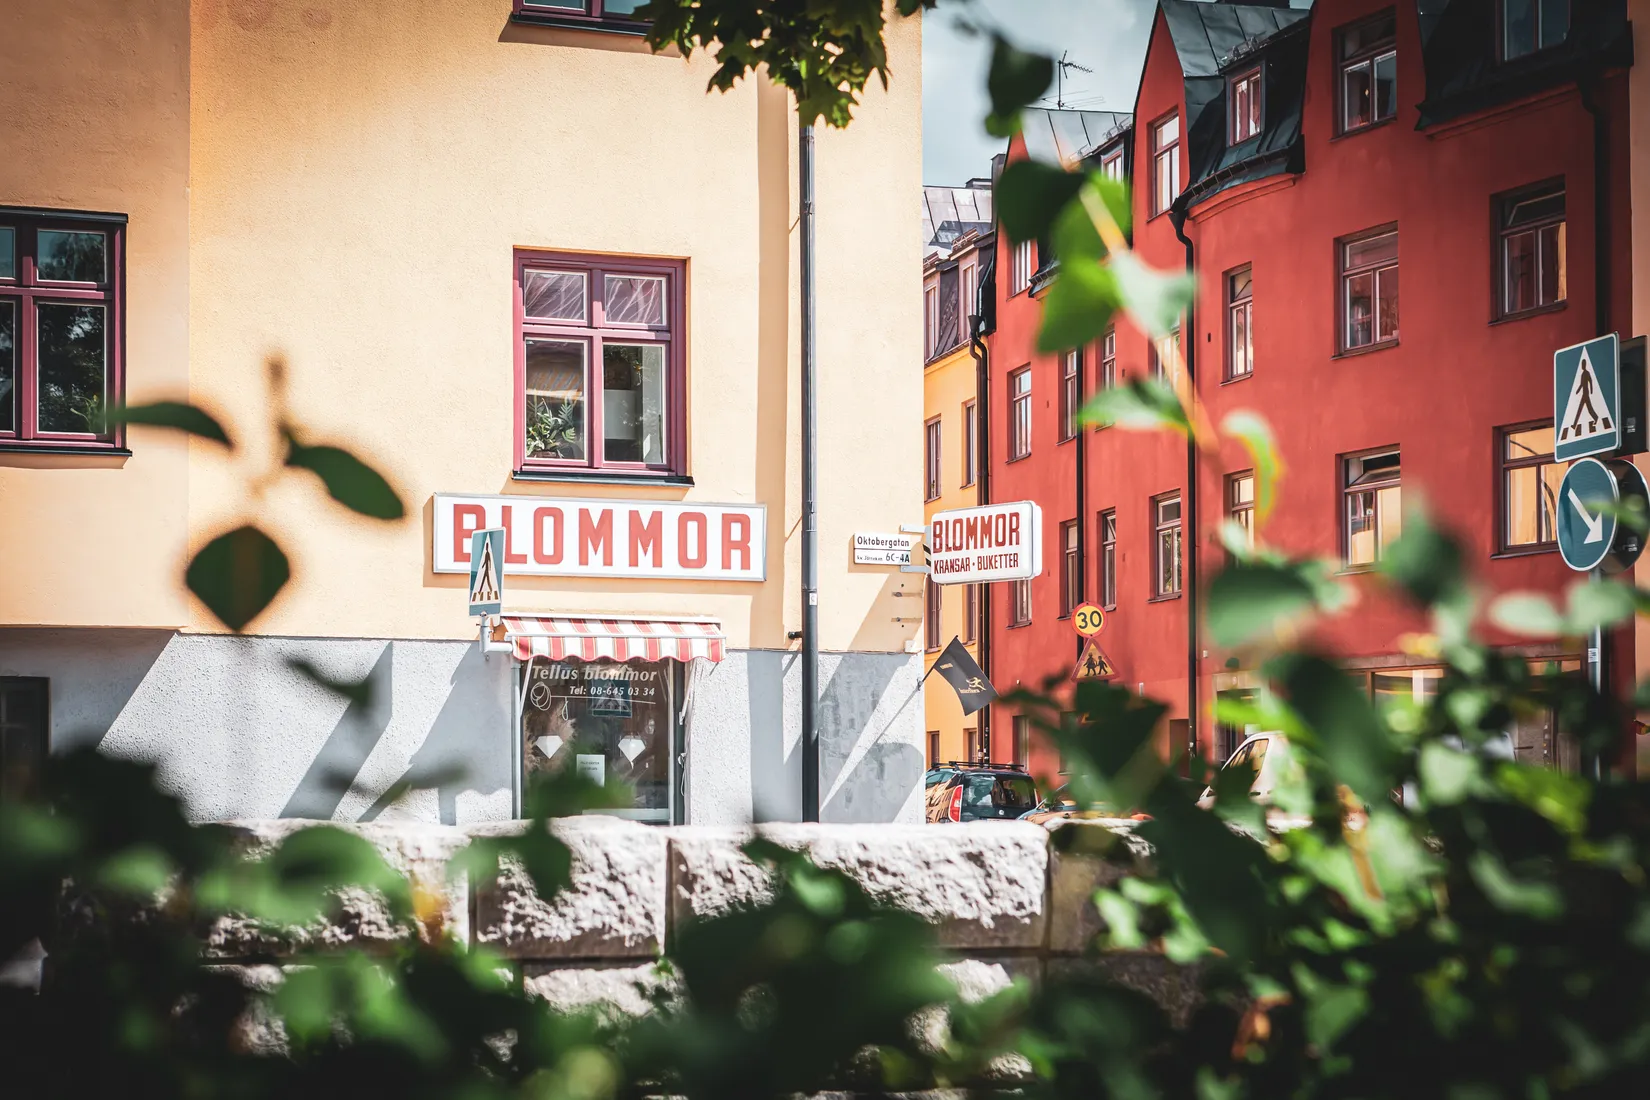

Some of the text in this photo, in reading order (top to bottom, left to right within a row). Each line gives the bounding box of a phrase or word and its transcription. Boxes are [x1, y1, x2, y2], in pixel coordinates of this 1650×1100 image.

[453, 503, 751, 570] BLOMMOR
[932, 511, 1020, 554] BLOMMOR
[857, 536, 910, 549] Oktobergatan
[933, 552, 1019, 575] KRANSAR BUKETTER
[1077, 610, 1102, 629] 30
[532, 664, 657, 682] Tellus blommor
[569, 685, 656, 697] Tel: 08-645 03 34
